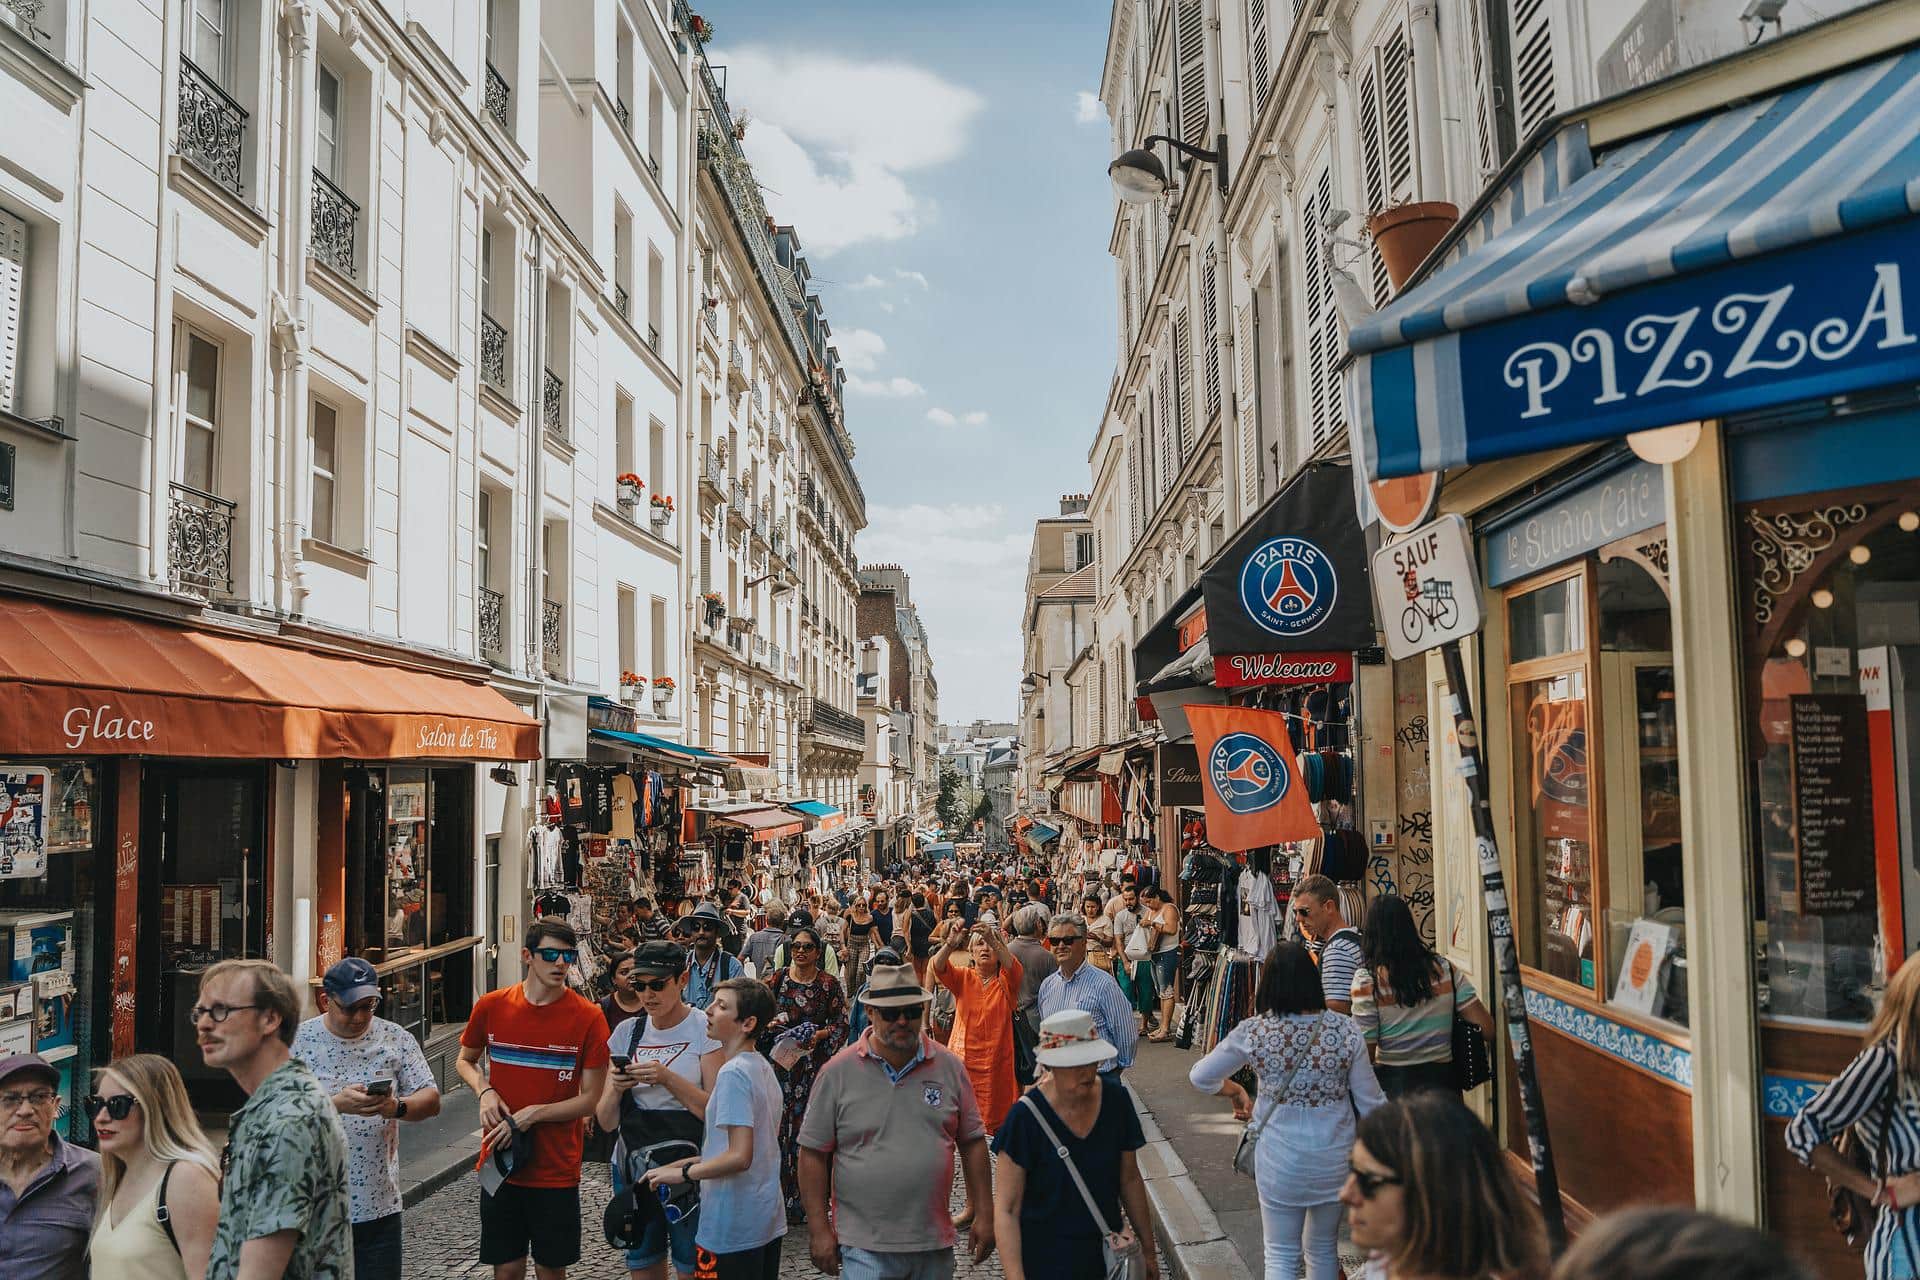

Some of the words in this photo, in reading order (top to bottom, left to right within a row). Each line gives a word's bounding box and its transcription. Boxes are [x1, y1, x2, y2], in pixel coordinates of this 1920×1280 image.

[1504, 263, 1918, 419] PIZZA
[1525, 505, 1593, 568] Studio
[1600, 473, 1649, 537] Café
[1255, 543, 1317, 568] PARIS
[1393, 532, 1438, 576] SAUF
[1231, 653, 1337, 681] Welcome
[63, 705, 155, 749] Glace
[416, 723, 455, 749] Salon
[460, 726, 474, 748] de
[477, 728, 497, 750] Thé
[558, 1070, 573, 1082] 94
